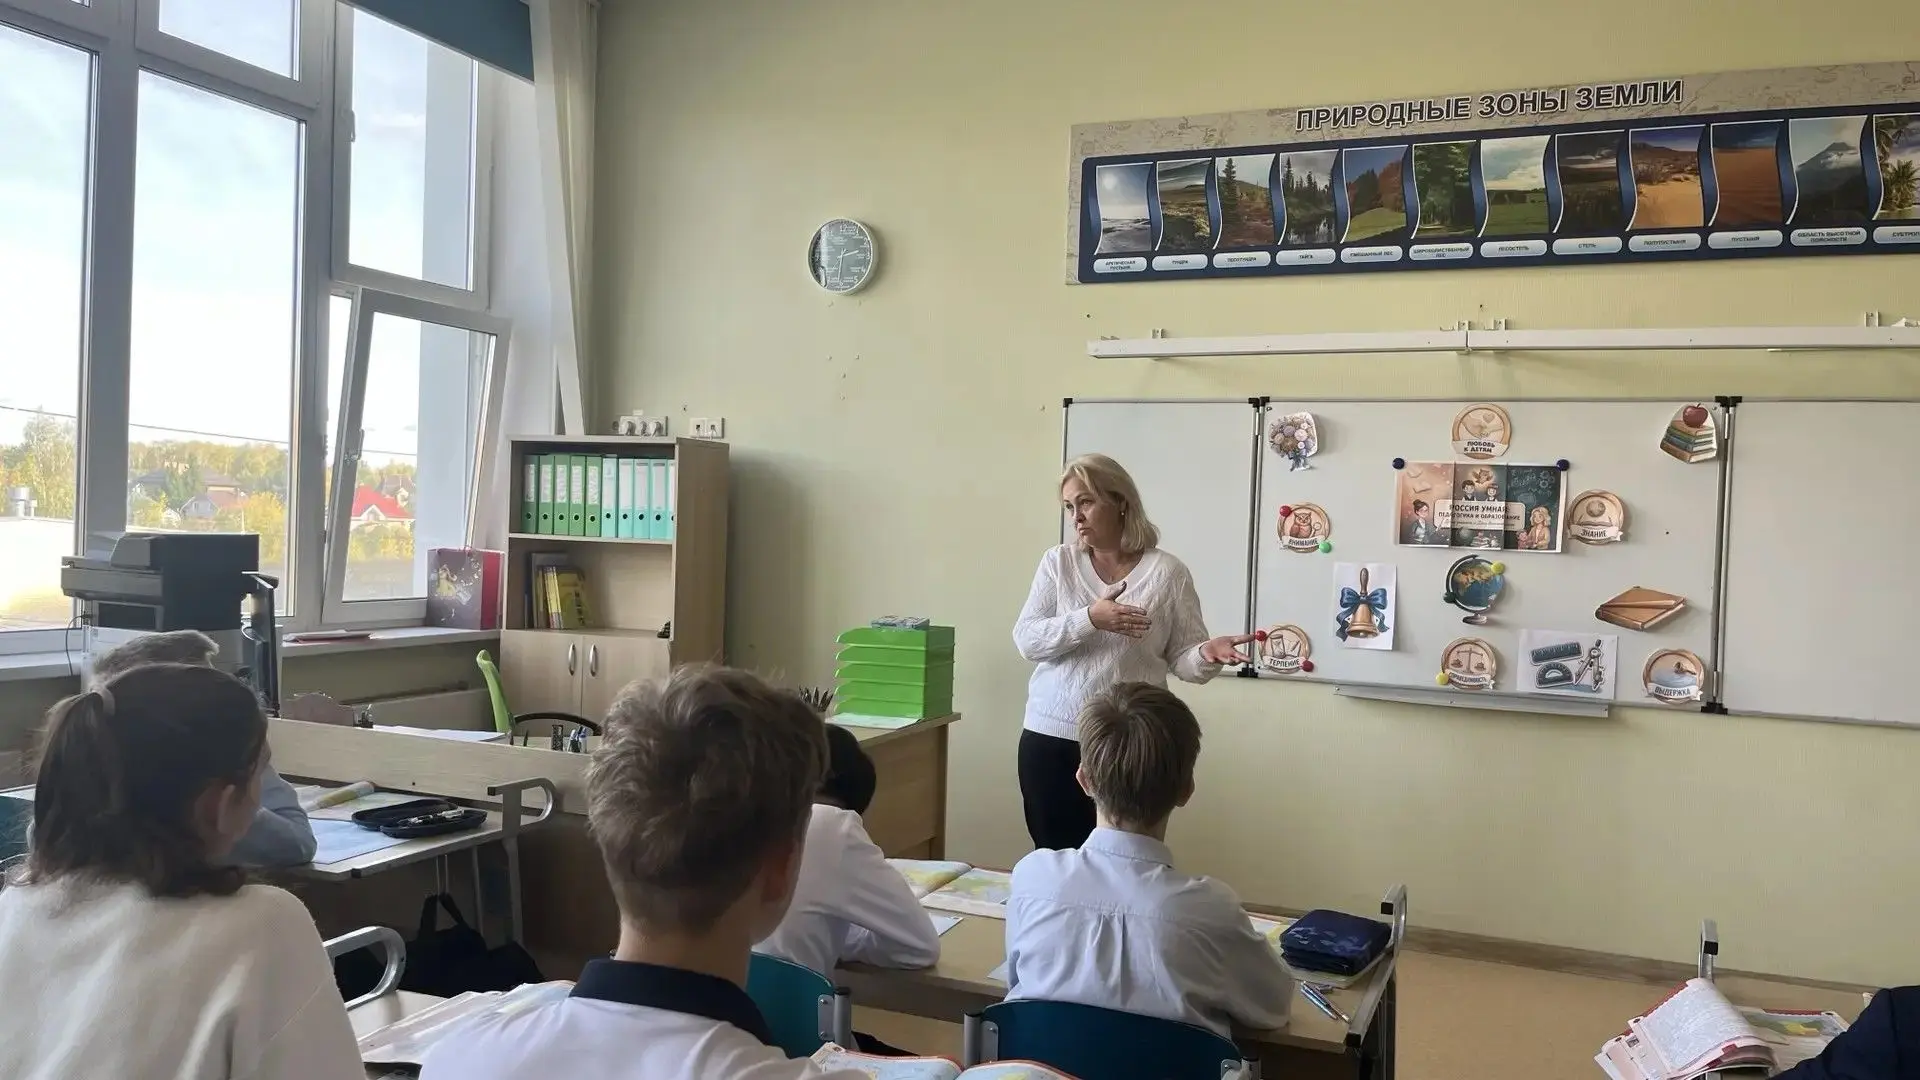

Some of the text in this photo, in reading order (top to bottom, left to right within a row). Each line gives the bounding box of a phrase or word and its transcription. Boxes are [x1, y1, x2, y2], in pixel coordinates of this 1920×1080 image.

[1296, 79, 1684, 130] ПРИРОДНЫЕ ЗОНЫ ЗЕМЛИ
[1269, 658, 1300, 668] ТЕРПЕНИЕ
[1654, 686, 1691, 696] ВЫДЕРЖКА
